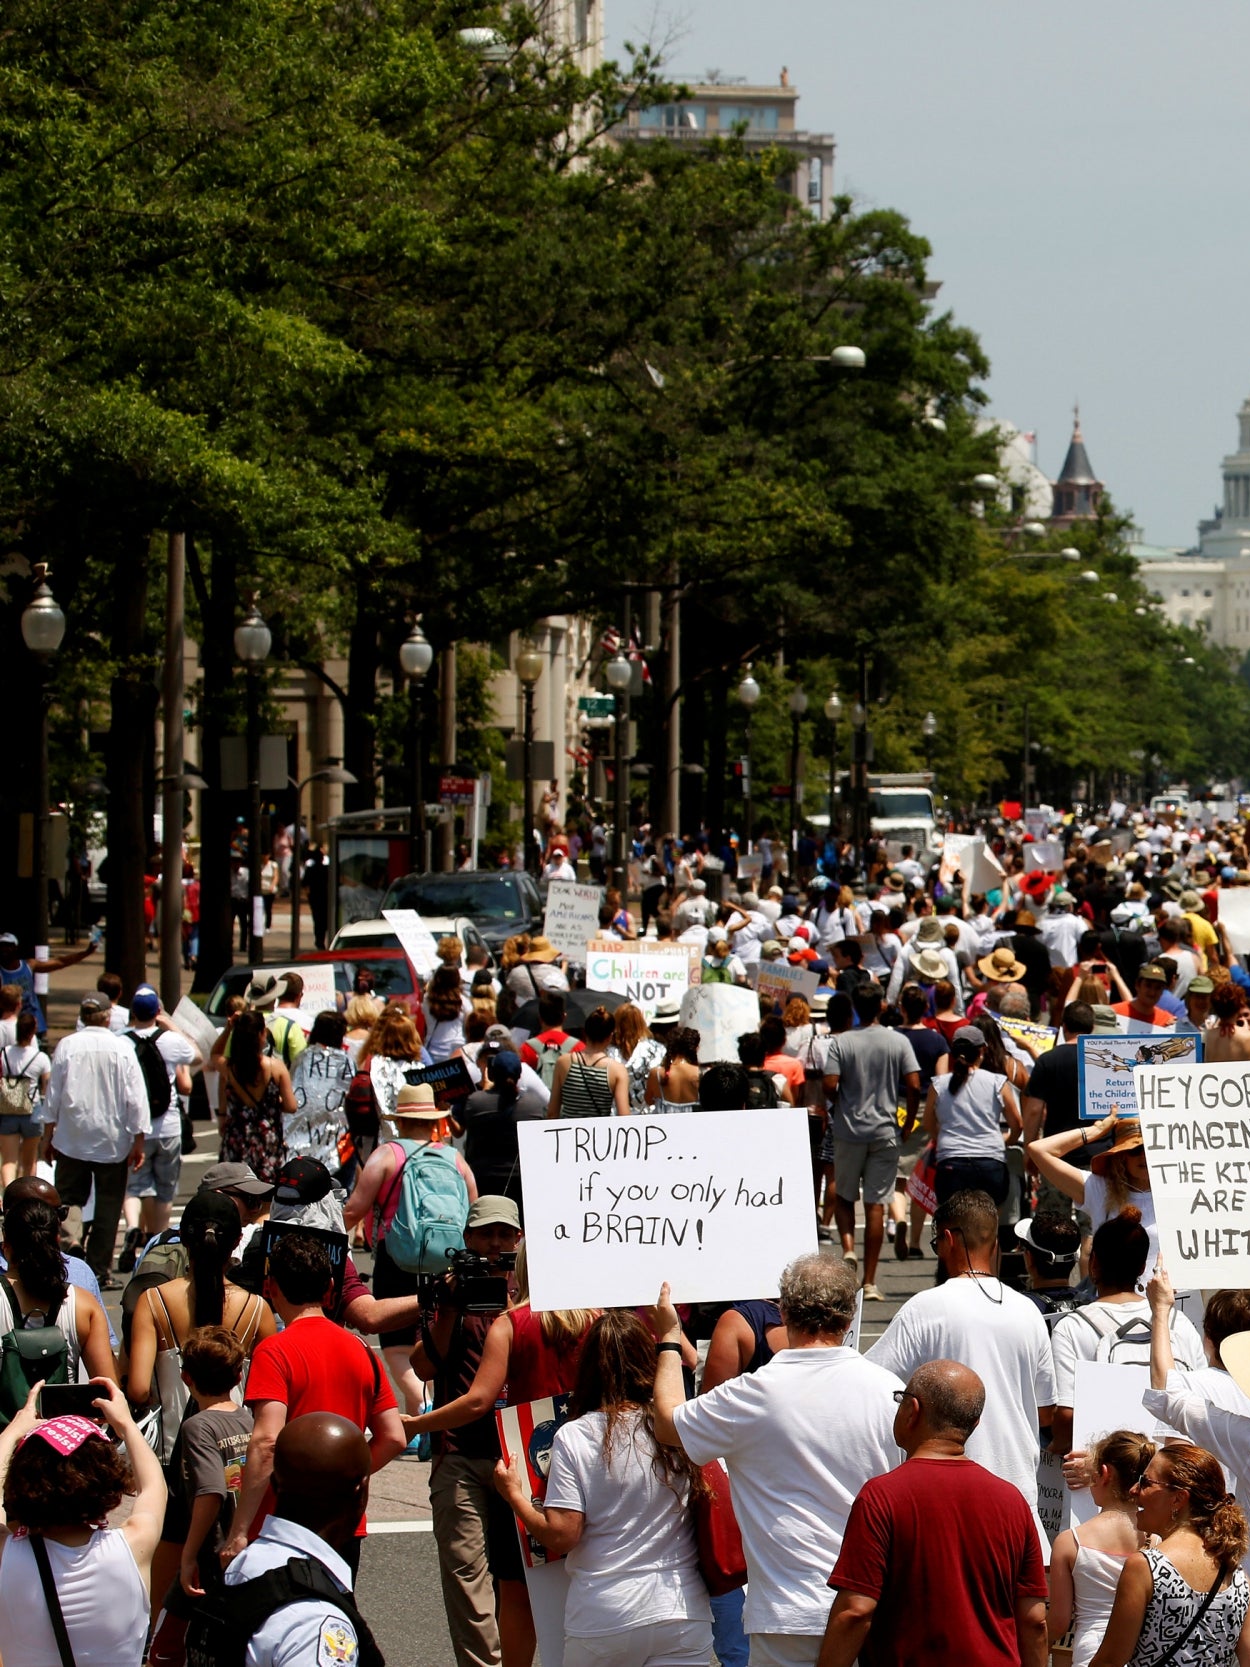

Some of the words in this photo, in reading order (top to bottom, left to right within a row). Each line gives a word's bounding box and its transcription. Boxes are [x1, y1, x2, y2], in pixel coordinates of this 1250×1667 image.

[592, 958, 659, 981] Children
[663, 970, 686, 982] are
[626, 982, 671, 1001] NOT
[1127, 1039, 1142, 1047] Apart
[421, 1063, 461, 1083] FAMILIAS
[1105, 1078, 1135, 1087] Return
[1089, 1090, 1103, 1098] the
[1104, 1089, 1136, 1098] Childre
[1139, 1074, 1193, 1111] HEY
[1092, 1102, 1113, 1110] Their
[1116, 1102, 1138, 1110] Famil
[543, 1124, 698, 1164] TRUMP...
[1151, 1160, 1206, 1185] THE
[578, 1171, 601, 1202] if
[606, 1185, 659, 1212] you
[670, 1175, 727, 1214] only
[733, 1176, 784, 1208] had
[1190, 1188, 1247, 1215] ARE
[554, 1222, 571, 1240] a
[582, 1211, 704, 1251] BRAIN!
[41, 1425, 77, 1451] resist
[51, 1420, 86, 1443] resist
